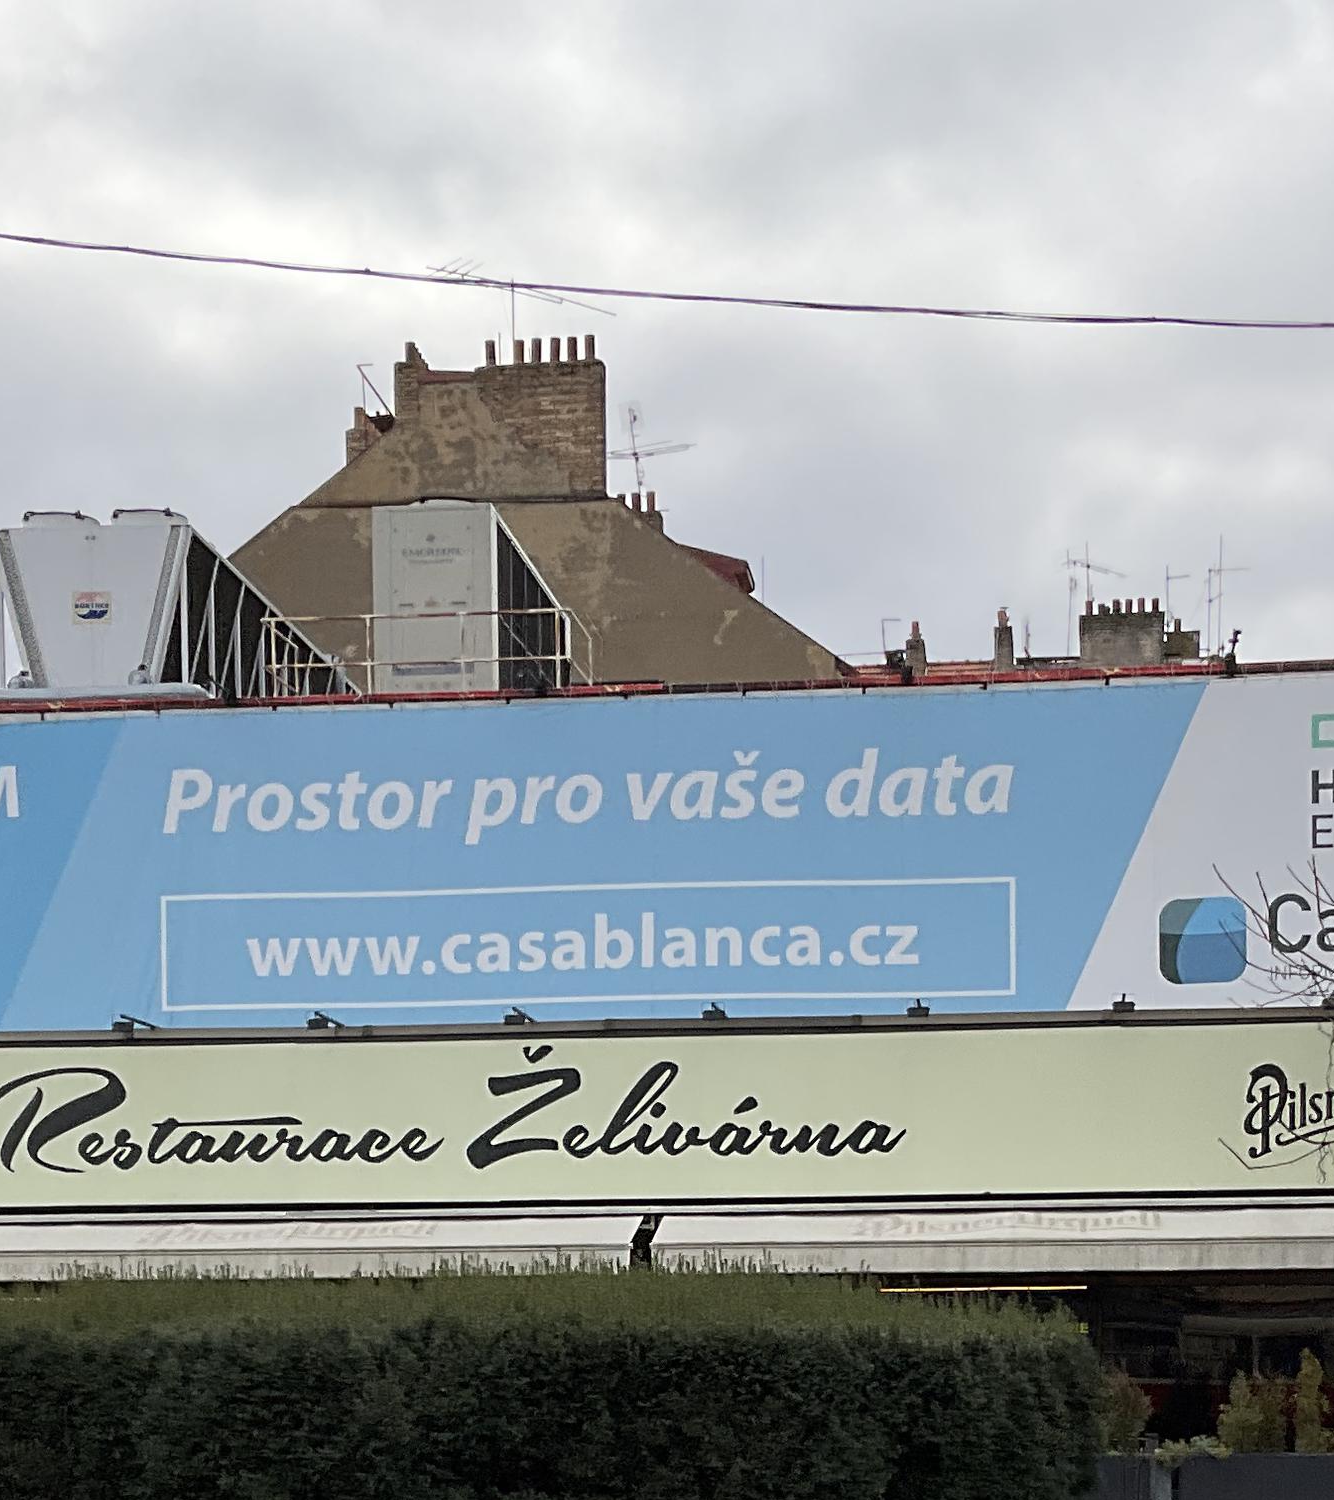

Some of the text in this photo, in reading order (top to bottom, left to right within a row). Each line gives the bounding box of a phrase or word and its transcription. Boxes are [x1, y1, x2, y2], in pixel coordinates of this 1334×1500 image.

[163, 748, 1015, 846] Prostor pro vaše data
[246, 911, 920, 977] www.casablanca.cz
[466, 1044, 908, 1170] Želivárna
